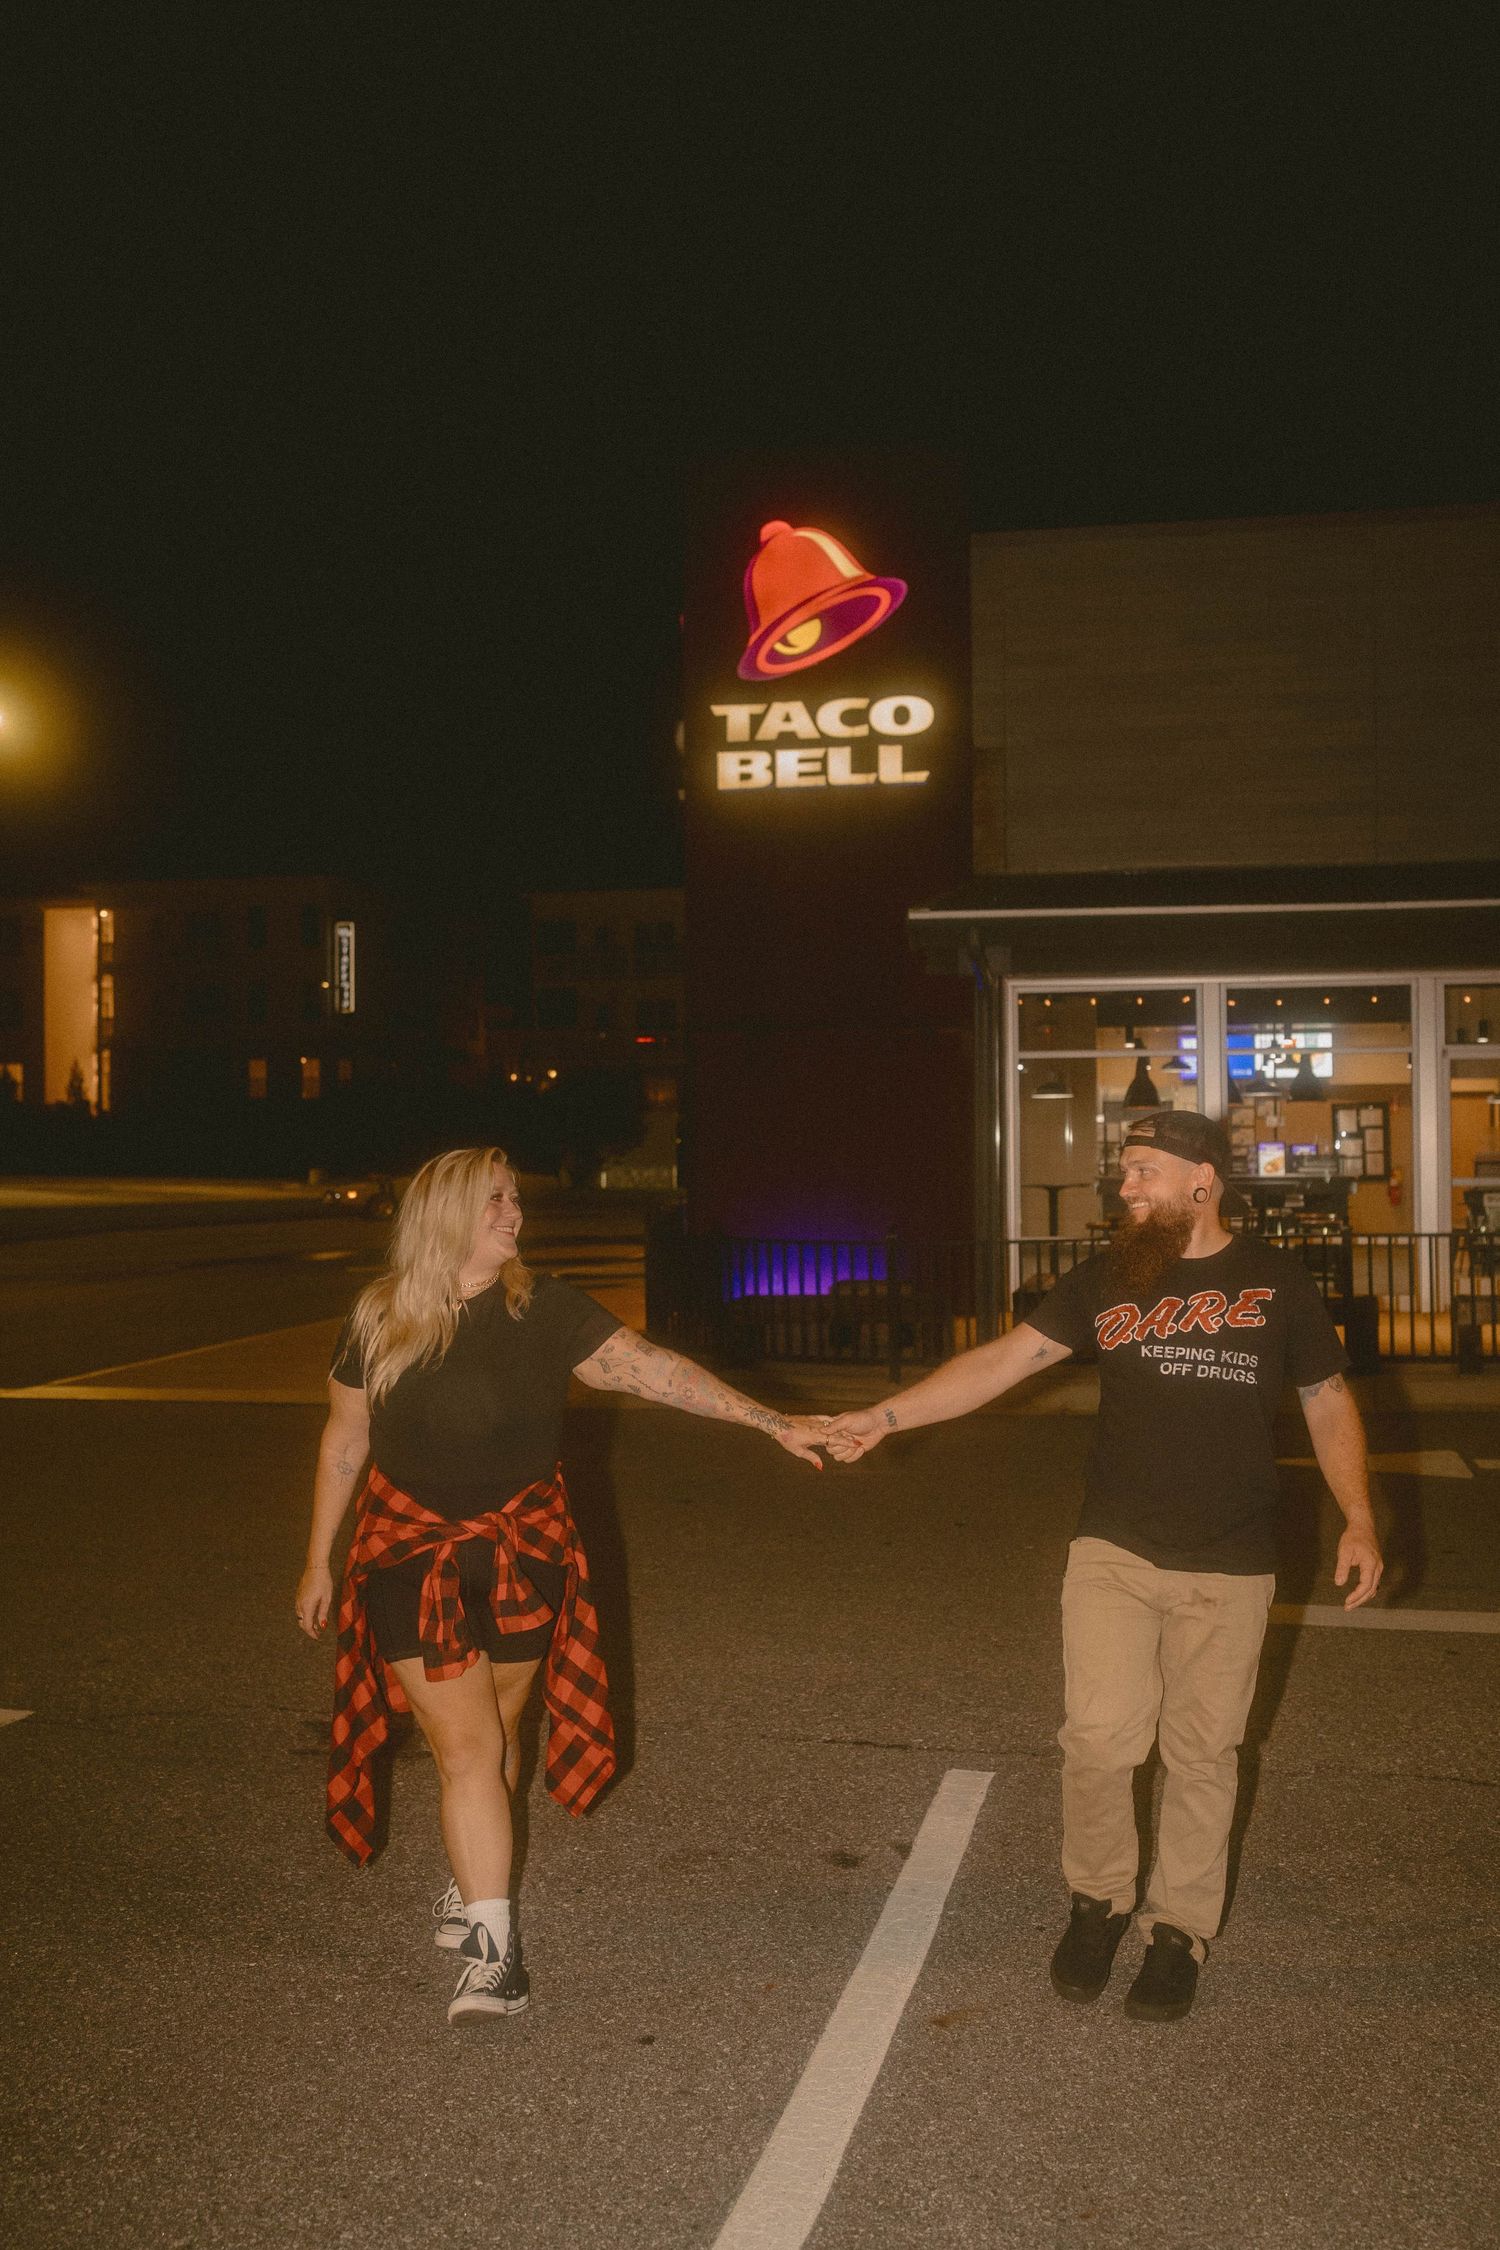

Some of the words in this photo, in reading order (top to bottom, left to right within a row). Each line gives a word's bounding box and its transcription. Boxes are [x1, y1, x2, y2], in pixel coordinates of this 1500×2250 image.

[710, 695, 935, 742] TACO
[716, 744, 930, 790] BELL
[1141, 1345, 1215, 1362] KEEPING
[1220, 1350, 1259, 1368] KIDS
[1160, 1362, 1192, 1376] OFF
[1197, 1365, 1258, 1385] DRUGS.
